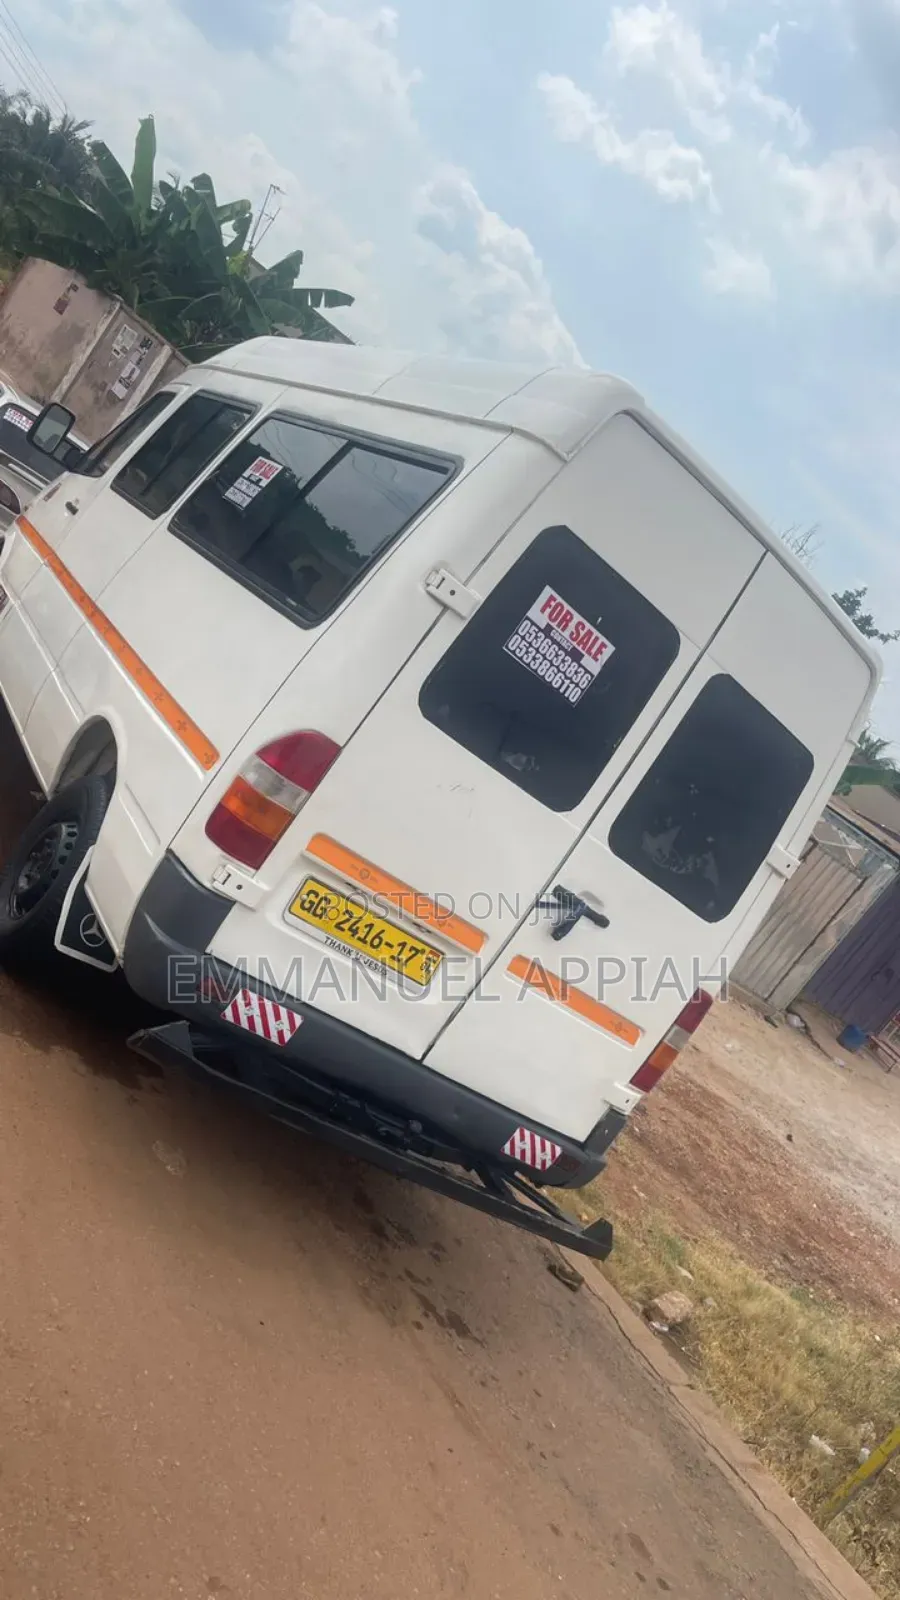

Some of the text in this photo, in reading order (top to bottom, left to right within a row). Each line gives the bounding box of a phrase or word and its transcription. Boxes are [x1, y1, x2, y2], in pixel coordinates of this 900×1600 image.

[518, 619, 591, 690] 0536633836
[540, 594, 608, 662] FOR SALE
[549, 629, 573, 651] CONTACT
[507, 635, 582, 704] 0533866110
[299, 889, 332, 920] GG
[334, 909, 422, 969] 2416-17
[324, 935, 353, 957] THANK
